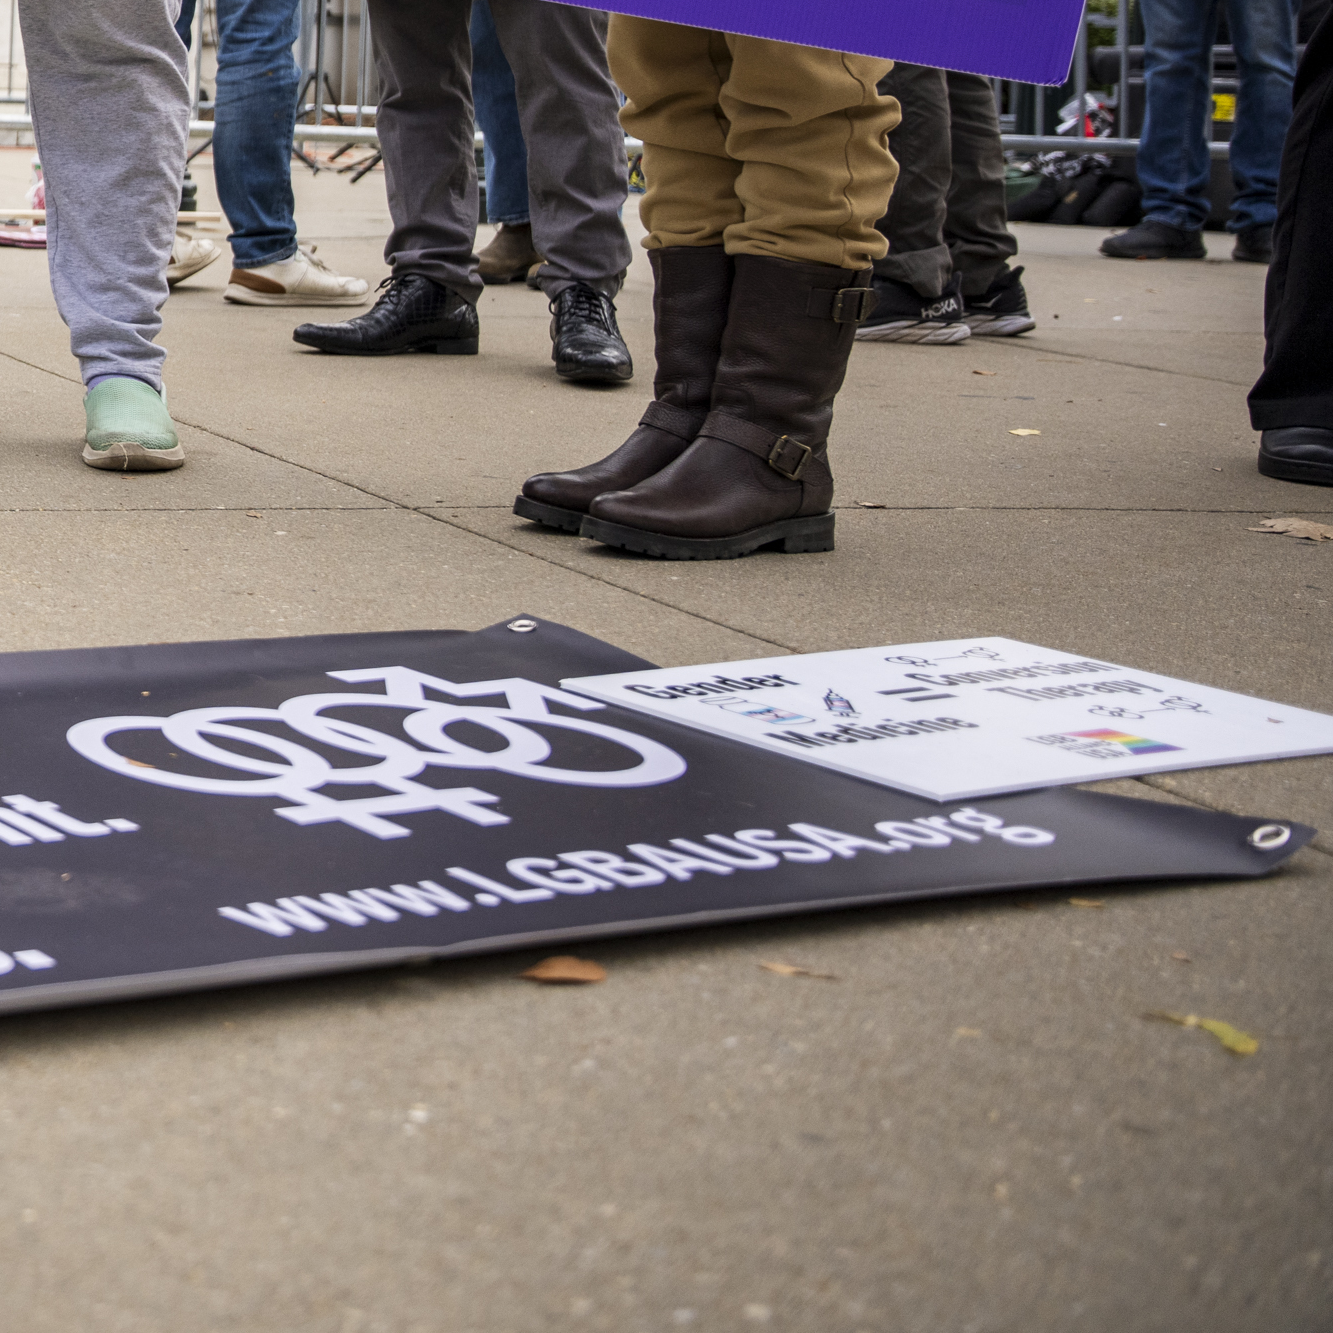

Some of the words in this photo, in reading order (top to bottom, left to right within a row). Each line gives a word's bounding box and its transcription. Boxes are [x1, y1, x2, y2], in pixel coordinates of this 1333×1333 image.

[921, 298, 958, 320] HOKA
[622, 670, 800, 700] Gender
[904, 660, 1120, 687] Conversion
[984, 678, 1165, 702] Therapy
[764, 714, 980, 749] Medicine
[219, 806, 1055, 938] www.LGBAUSA.org
